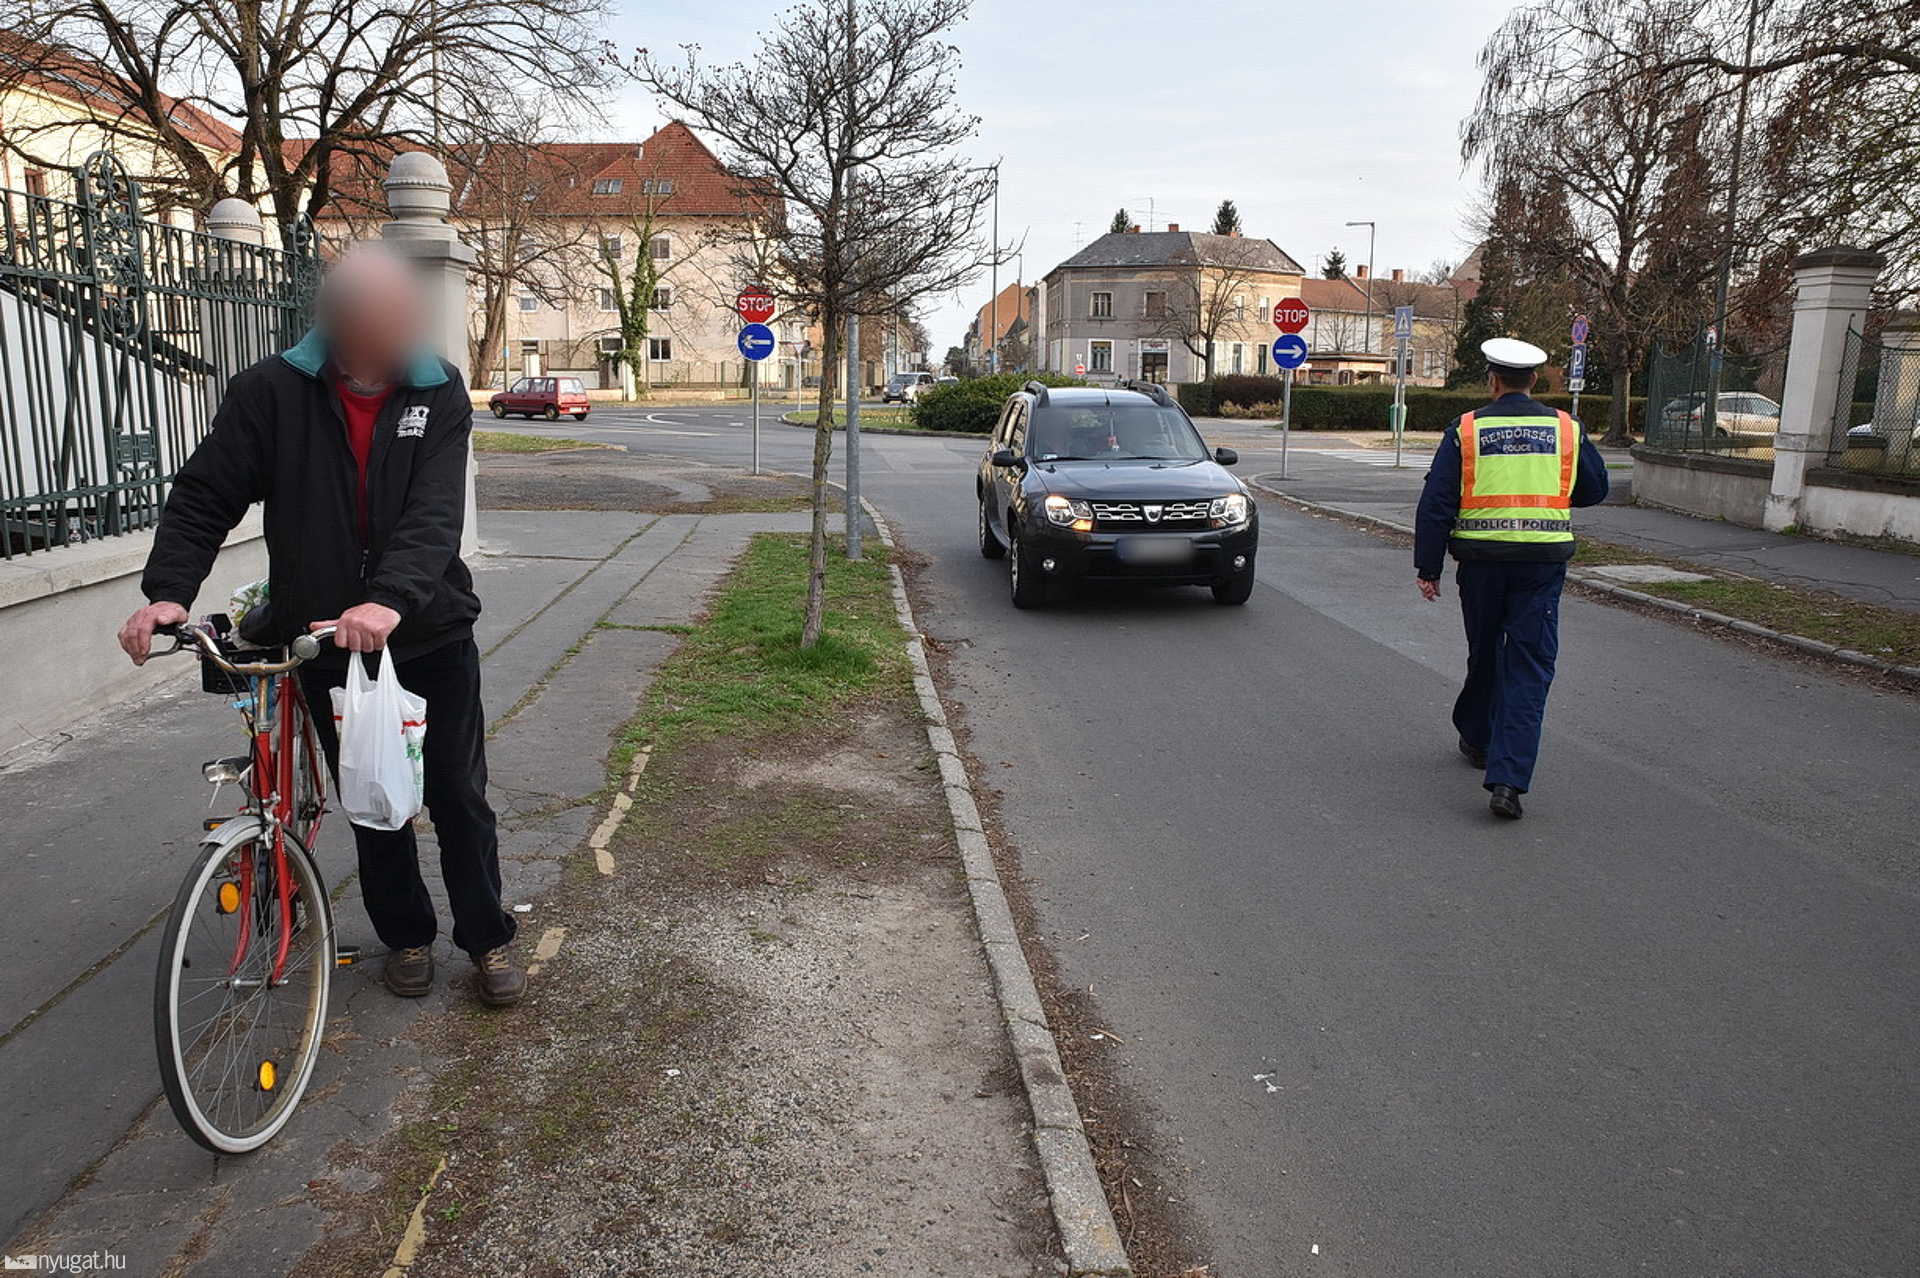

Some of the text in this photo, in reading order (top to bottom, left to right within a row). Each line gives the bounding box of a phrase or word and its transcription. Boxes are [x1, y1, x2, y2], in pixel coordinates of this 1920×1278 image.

[739, 297, 773, 311] STOP
[1275, 309, 1308, 323] STOP
[1502, 443, 1532, 453] POLICE
[1474, 520, 1517, 529] POLICE
[1521, 520, 1560, 530] POLICE
